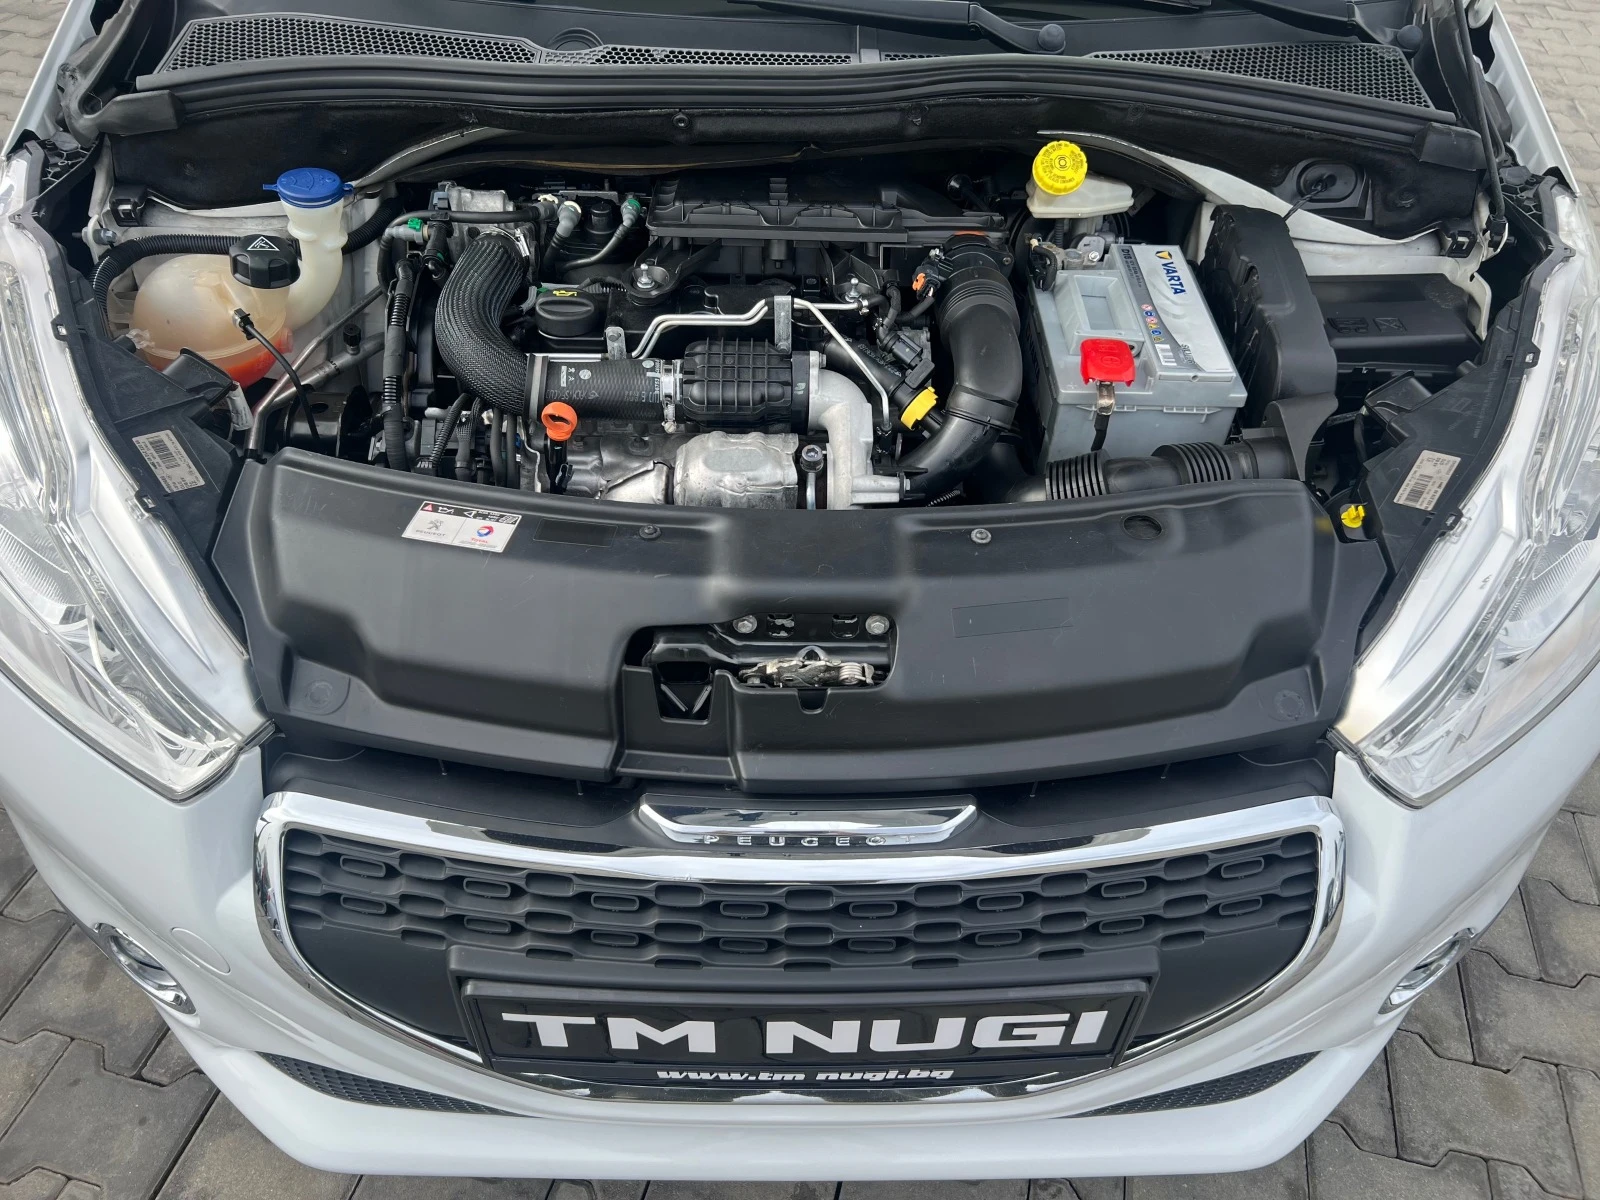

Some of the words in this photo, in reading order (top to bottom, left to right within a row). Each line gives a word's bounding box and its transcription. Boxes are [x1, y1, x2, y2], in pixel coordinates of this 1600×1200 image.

[1161, 261, 1187, 295] VARTA
[415, 529, 446, 537] PEUGEOT
[704, 834, 916, 847] PEUGEOT
[502, 1012, 716, 1054] TM
[766, 1011, 1108, 1054] NUGI
[656, 1070, 805, 1081] www.tm
[816, 1068, 955, 1082] nugi.bg
